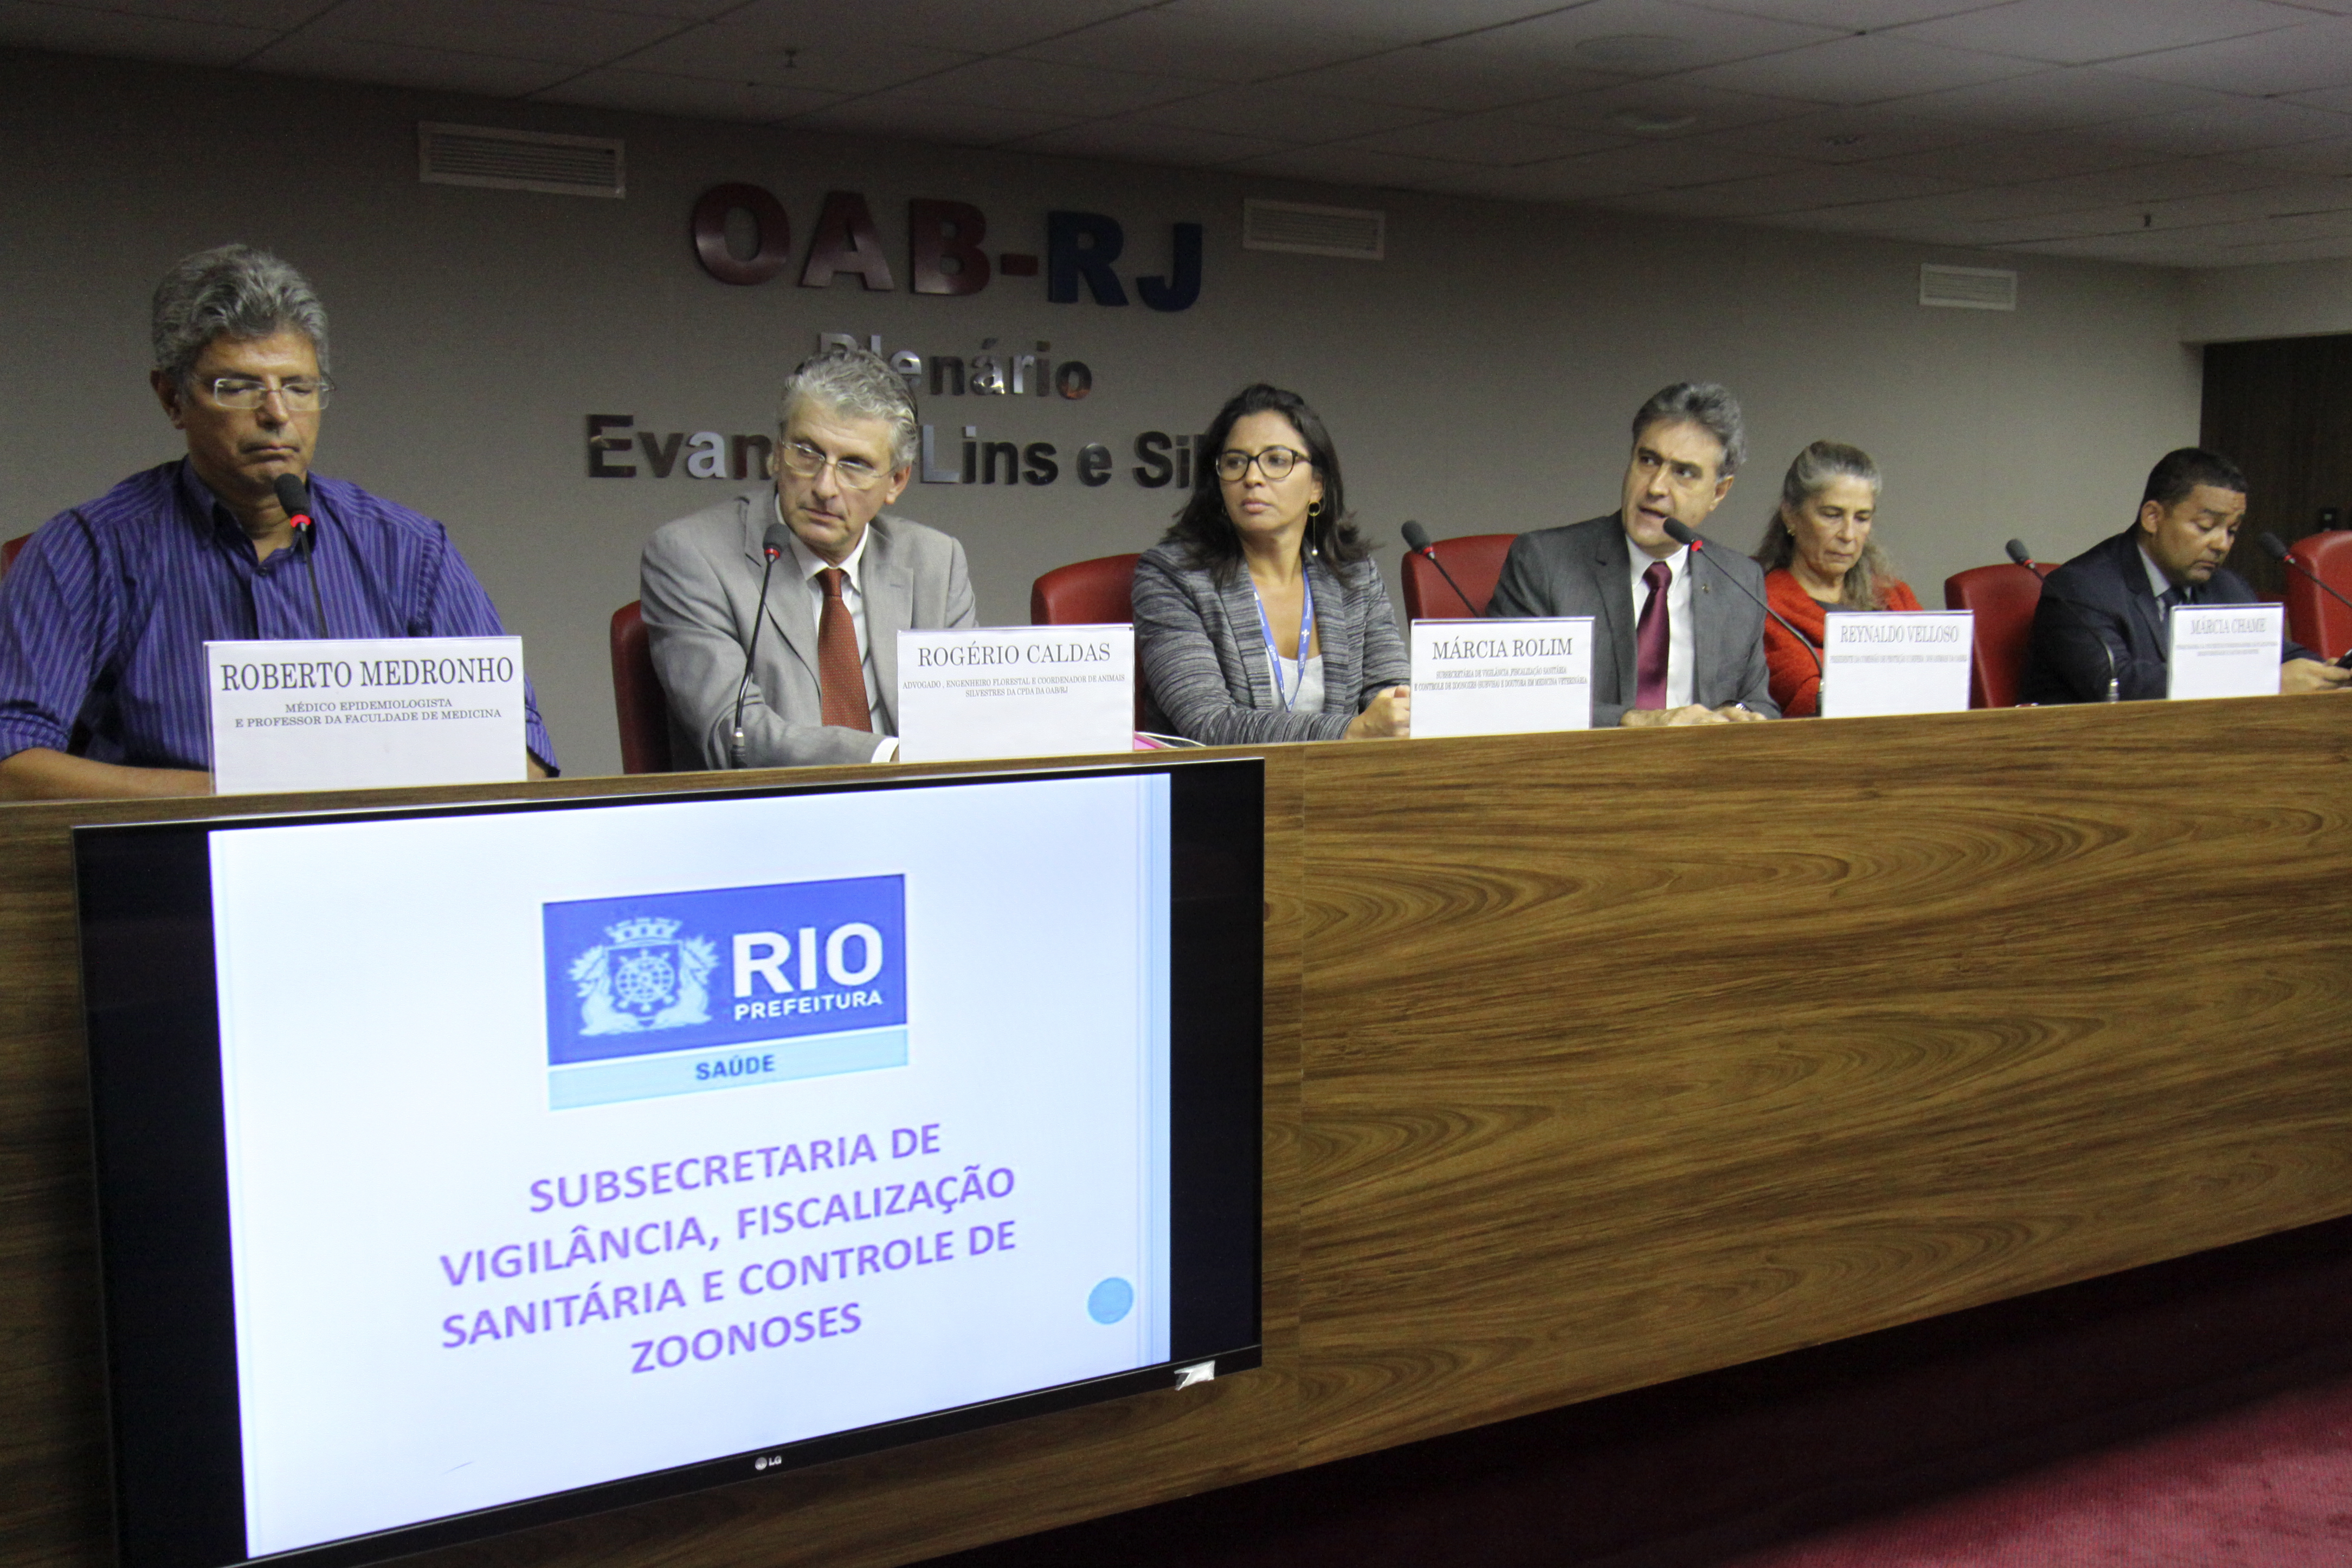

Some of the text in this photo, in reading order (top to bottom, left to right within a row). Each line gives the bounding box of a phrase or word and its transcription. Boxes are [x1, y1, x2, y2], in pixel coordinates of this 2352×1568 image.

[691, 182, 1203, 313] OAB-RJ
[919, 425, 1058, 487] Lins
[1077, 443, 1112, 487] e
[1433, 636, 1572, 659] MÁRCIA ROLIM
[1840, 625, 1959, 643] REYNALDO VELLOSO
[919, 641, 1110, 666] ROGÉRIO CALDAS
[221, 657, 513, 691] ROBERTO MEDRONHO
[946, 679, 991, 687] ENGENHEIRO
[1038, 676, 1086, 684] COORDENADOR
[286, 699, 452, 713] MÉDICO EPIDEMIOLOGISTA
[966, 689, 1005, 697] SILVESTRES
[236, 709, 501, 727] E PROFESSOR DA FACULDADE DE MEDICINA
[732, 922, 884, 998] RIO
[734, 991, 884, 1021] PREFEITURA
[696, 1055, 774, 1080] SAÚDE
[529, 1124, 942, 1214] SUBSECRETARIA DE
[440, 1165, 1015, 1287] VIGILÂNCIA, FISCALIZAÇÃO
[441, 1221, 1017, 1349] SANITÁRIA E CONTROLE DE
[630, 1303, 863, 1374] ZOONOSES
[769, 1455, 782, 1466] LG
